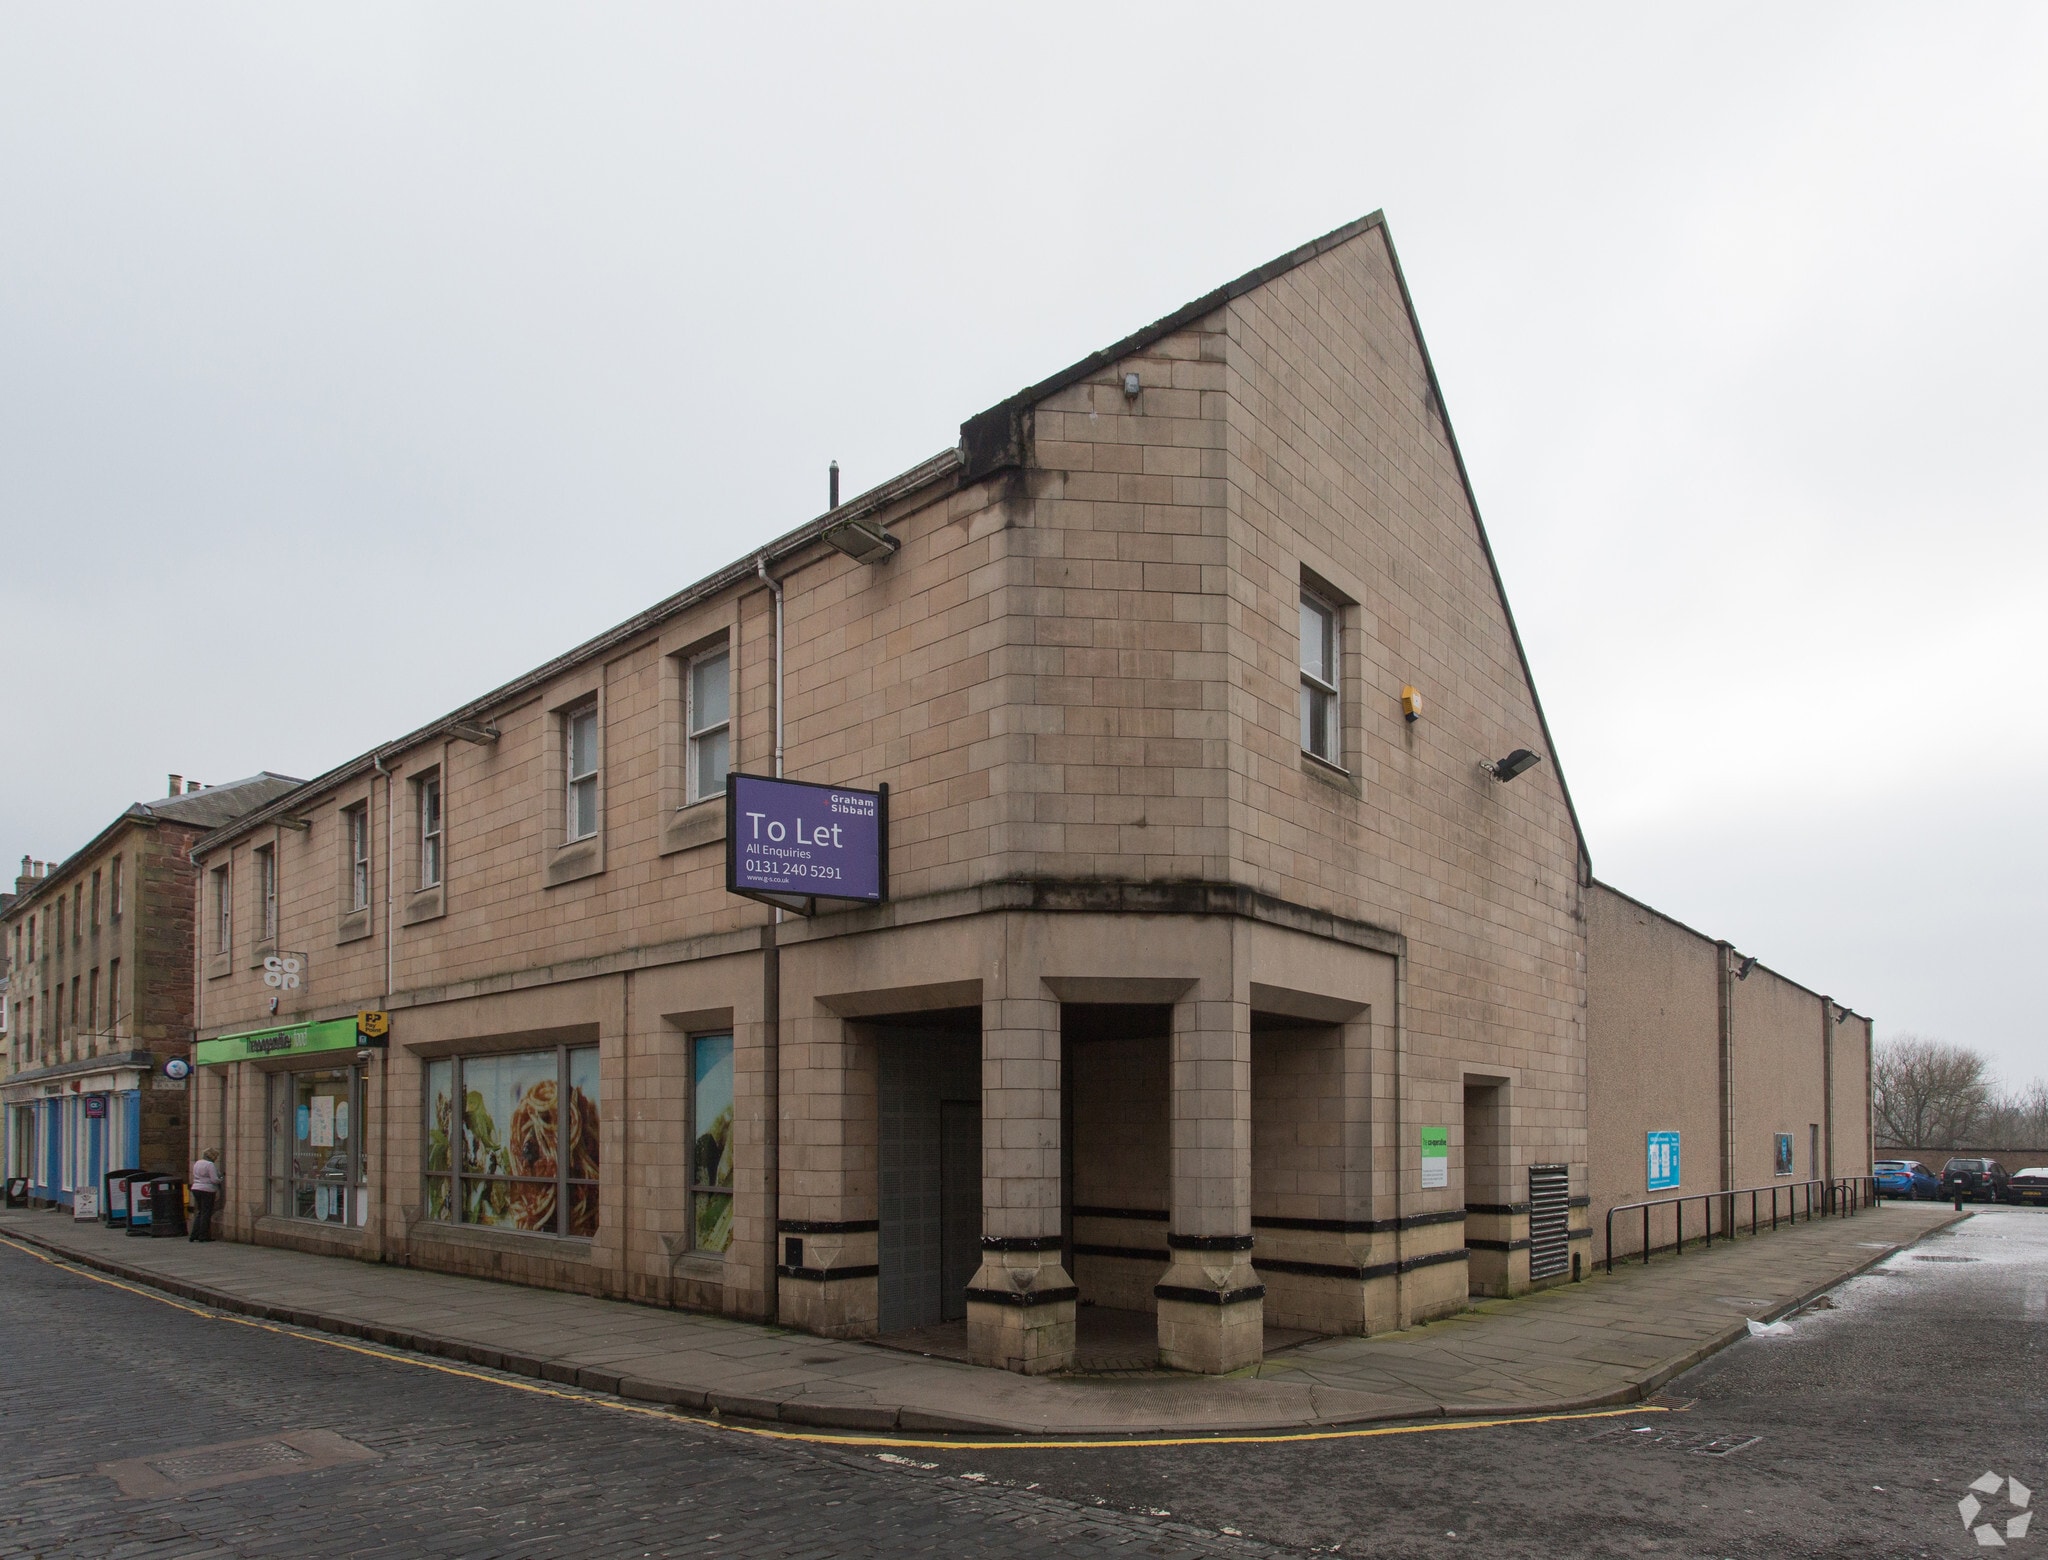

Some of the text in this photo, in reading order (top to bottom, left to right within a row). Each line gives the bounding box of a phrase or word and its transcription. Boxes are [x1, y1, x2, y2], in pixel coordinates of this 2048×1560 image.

[831, 794, 874, 807] Graham
[831, 804, 874, 816] Sibbald
[746, 812, 843, 848] To Let
[746, 843, 811, 859] All Enquiries
[746, 859, 842, 880] 0131 240 5291
[746, 875, 789, 883] www.g-s.co.uk
